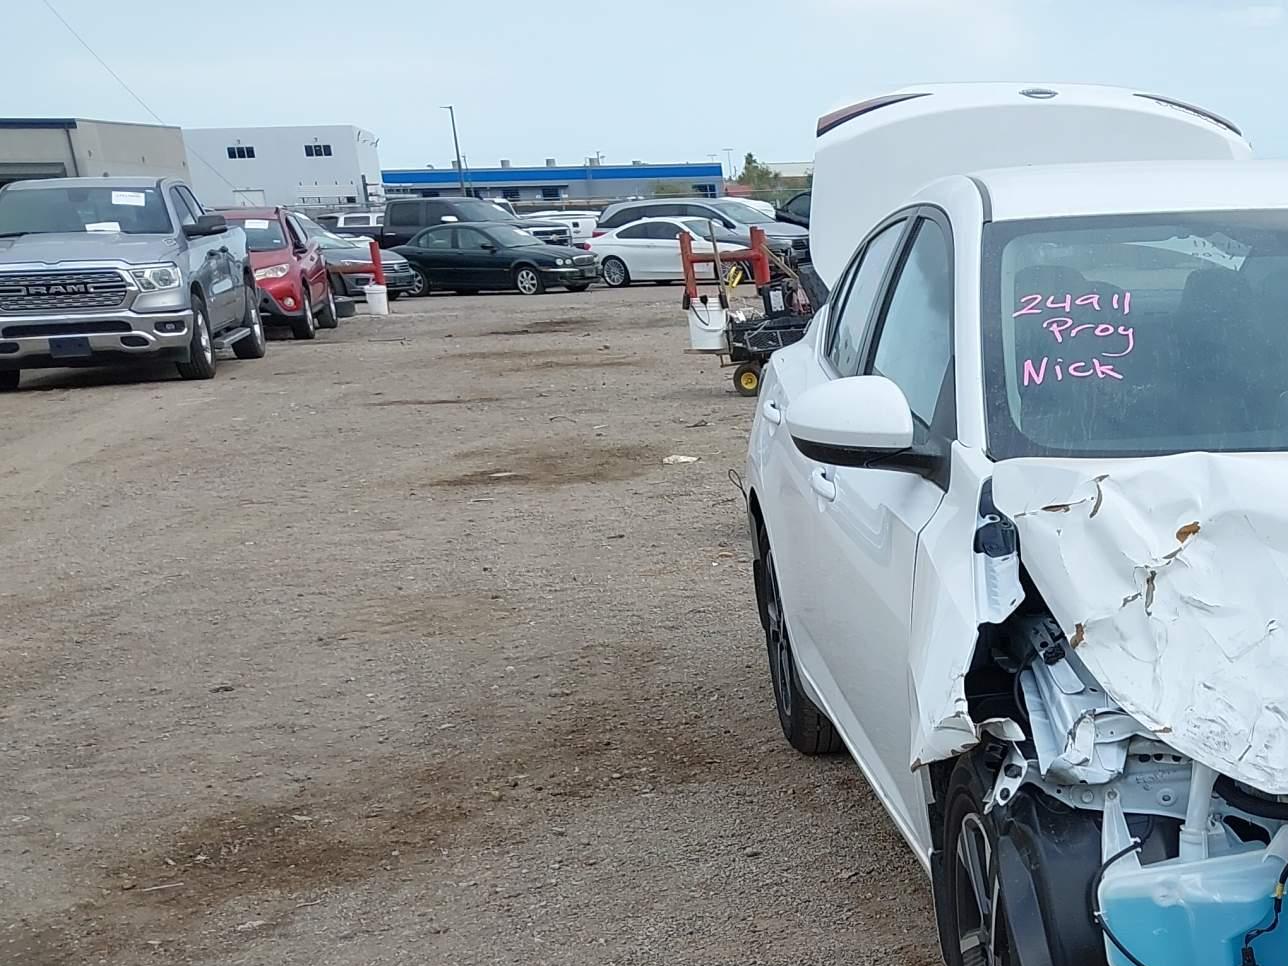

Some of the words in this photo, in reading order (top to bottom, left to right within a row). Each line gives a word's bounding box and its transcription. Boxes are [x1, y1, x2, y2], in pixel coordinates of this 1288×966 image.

[28, 284, 85, 295] RAM
[1012, 292, 1132, 318] 24911
[1023, 357, 1124, 387] Nick
